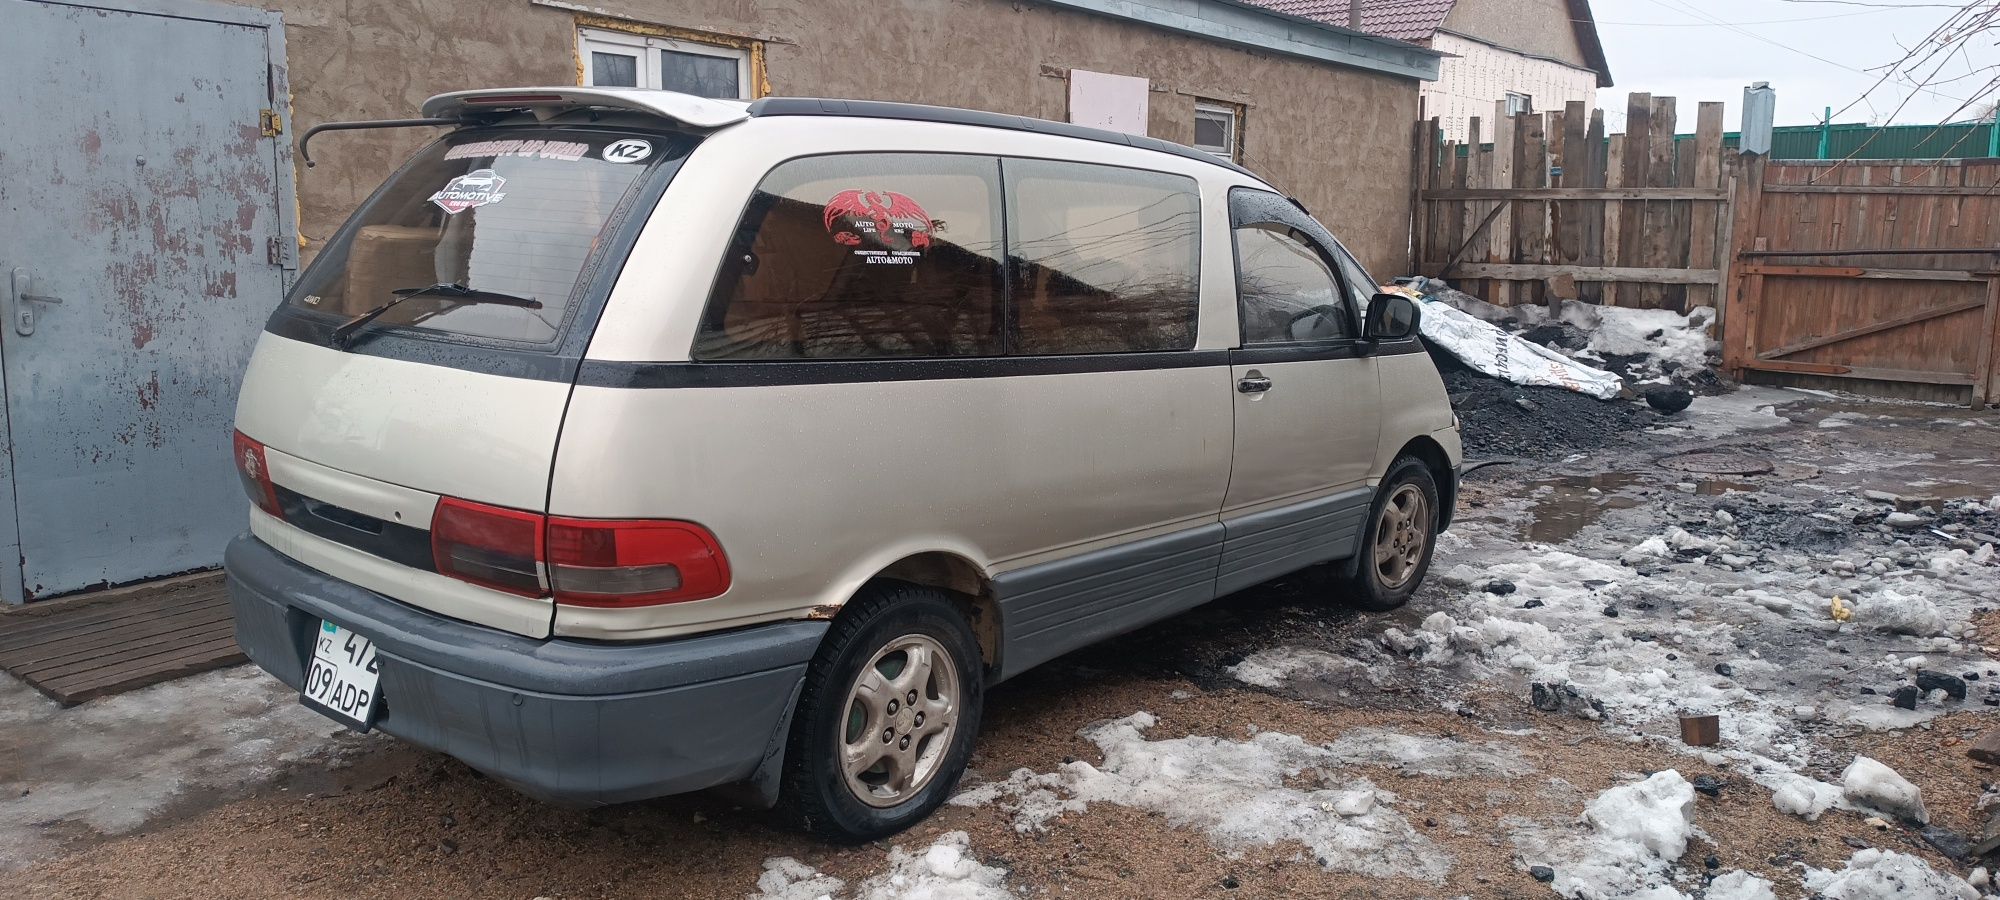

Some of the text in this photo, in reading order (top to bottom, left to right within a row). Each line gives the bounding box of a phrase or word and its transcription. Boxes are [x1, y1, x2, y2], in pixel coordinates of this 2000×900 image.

[611, 144, 647, 159] KZ
[426, 190, 507, 204] AUTOMOTIVE
[866, 256, 913, 264] AUTO&MOTO
[318, 637, 333, 654] KZ
[308, 663, 370, 716] 09 ADP
